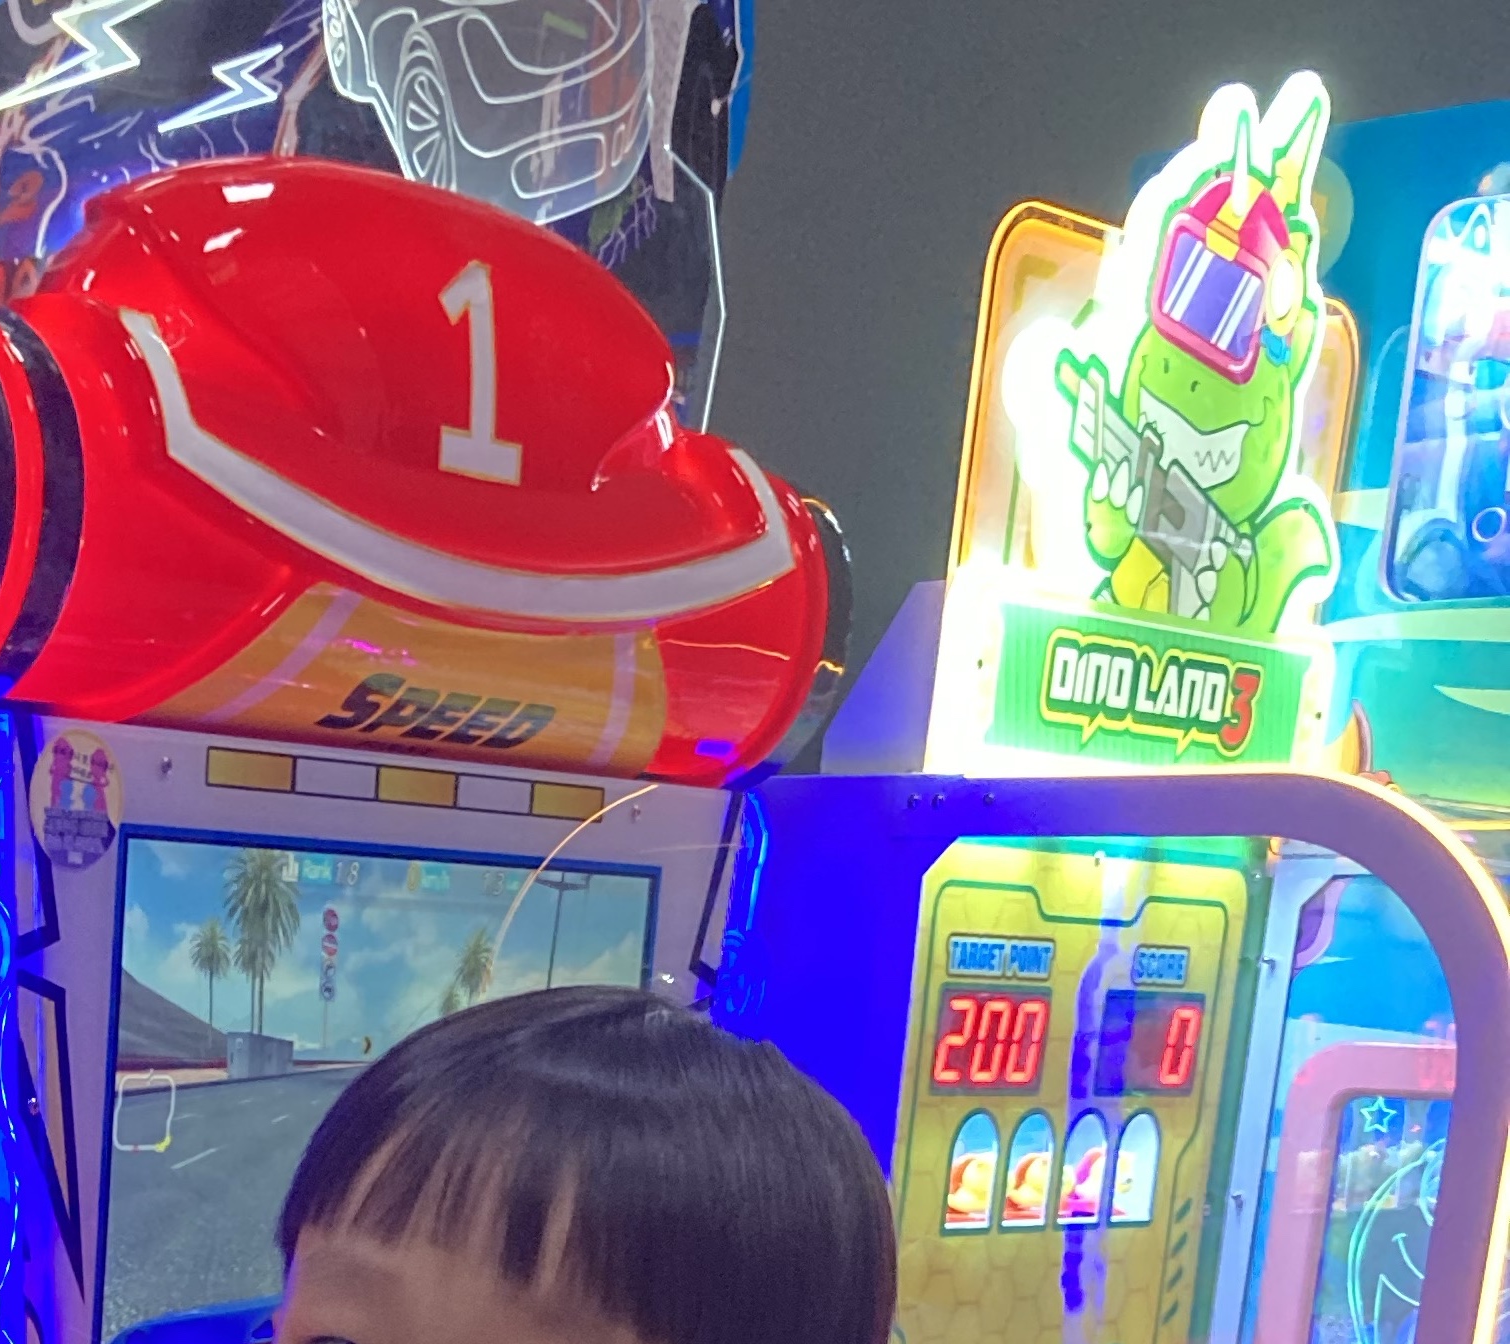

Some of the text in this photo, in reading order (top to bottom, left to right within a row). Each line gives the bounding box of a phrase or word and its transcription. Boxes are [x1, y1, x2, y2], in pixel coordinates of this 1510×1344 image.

[437, 259, 523, 486] 1
[315, 672, 557, 750] SPEED
[1049, 642, 1261, 752] DINO LAND 3
[949, 940, 1052, 977] TARGET POINT
[1135, 948, 1185, 984] SCORE
[932, 997, 1047, 1085] 200
[1157, 1006, 1202, 1087] 0
